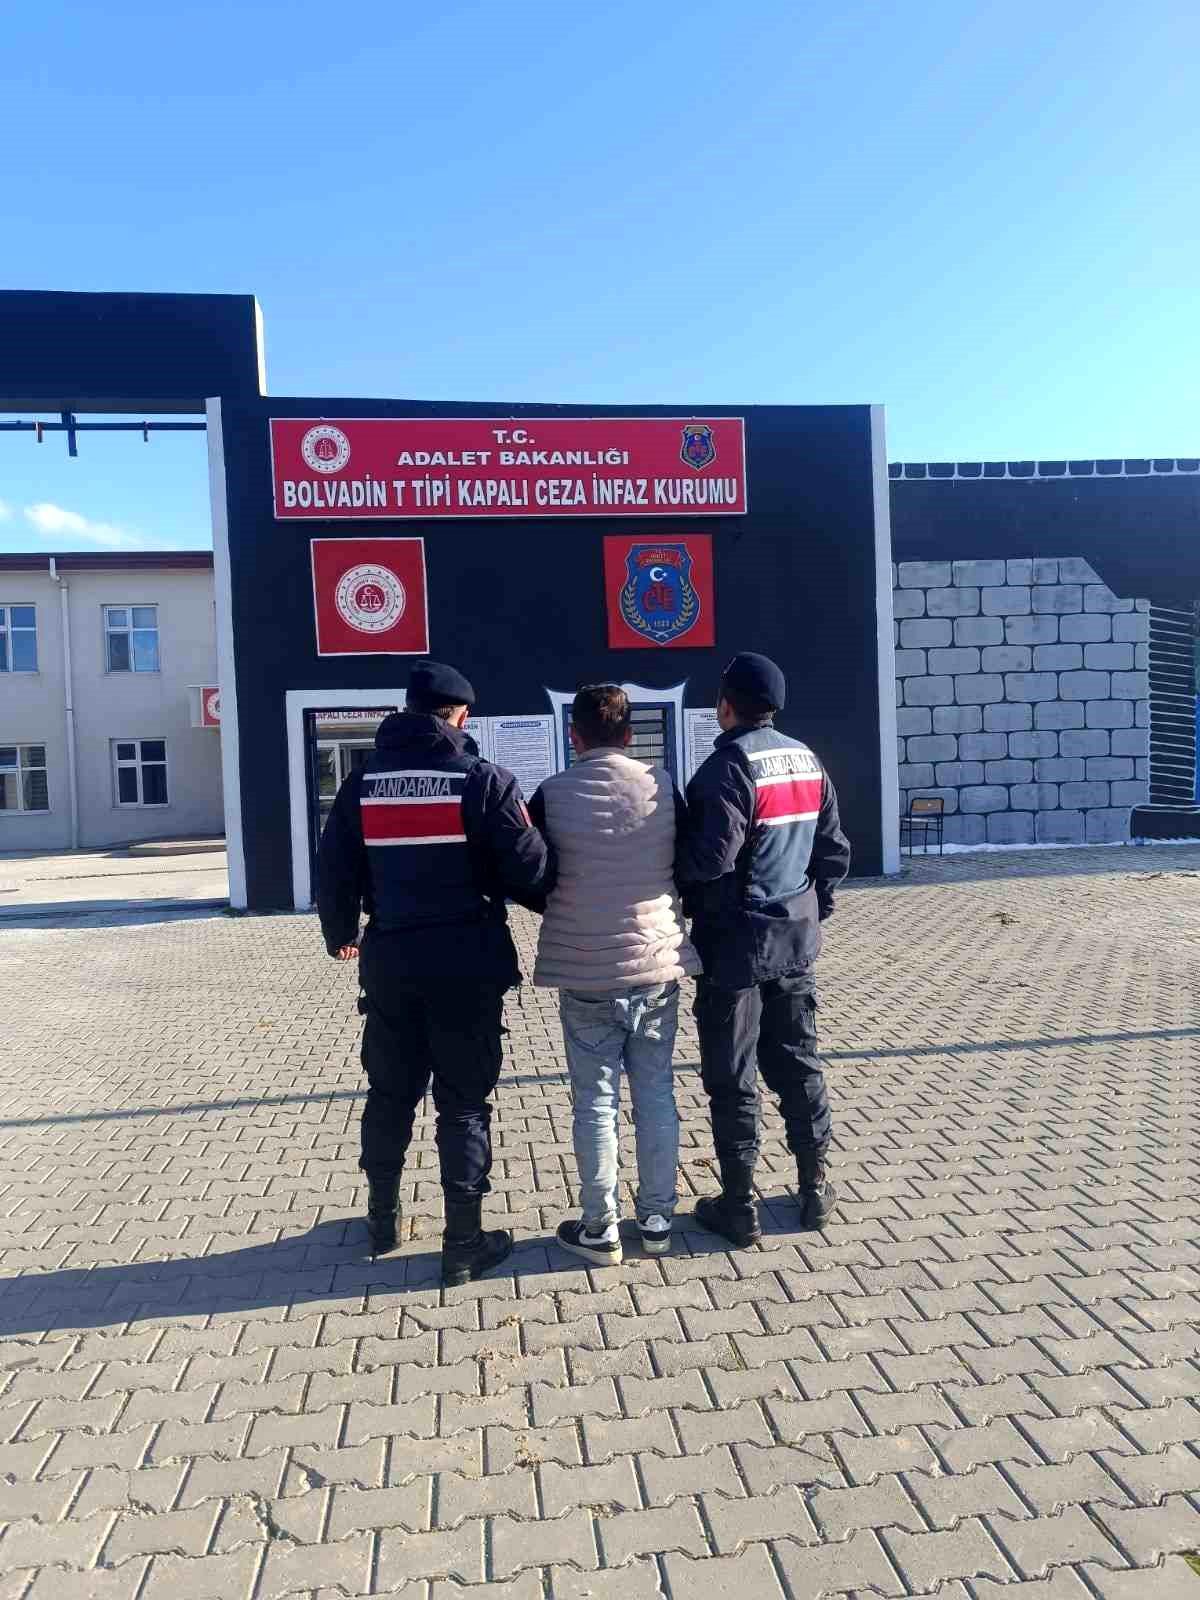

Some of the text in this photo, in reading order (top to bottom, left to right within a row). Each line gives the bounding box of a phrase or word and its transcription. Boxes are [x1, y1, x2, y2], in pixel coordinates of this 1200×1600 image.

[492, 430, 535, 444] T.C.
[398, 448, 630, 466] ADALET BAKANLIĞI
[283, 473, 737, 508] BOLVADİN T TİPİ KAPALI CEZA İNFAZ KURUMU
[760, 754, 818, 777] JANDARMA
[368, 777, 451, 798] JANDARMA
